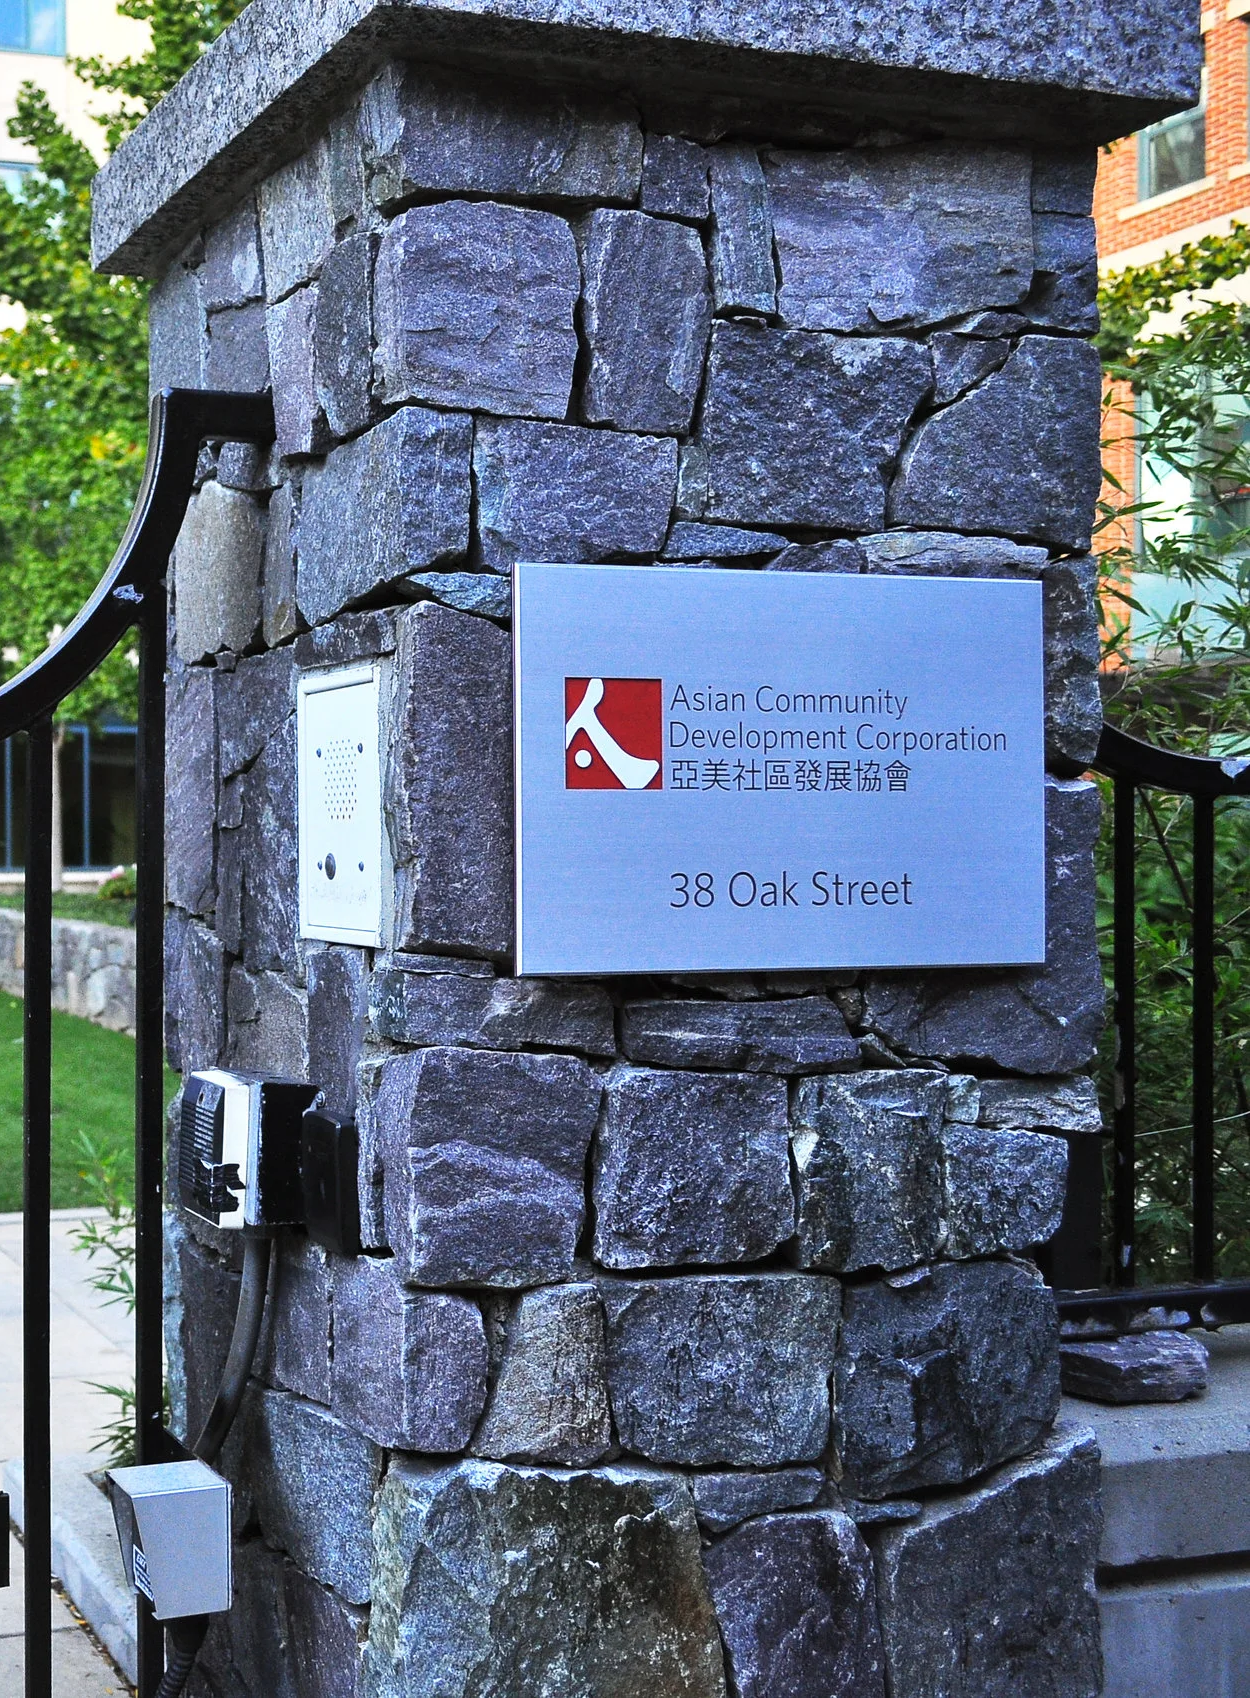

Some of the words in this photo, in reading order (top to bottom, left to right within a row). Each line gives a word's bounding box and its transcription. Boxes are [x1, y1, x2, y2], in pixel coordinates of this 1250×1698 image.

[669, 683, 746, 712] Asian
[755, 685, 909, 721] Community
[669, 721, 848, 756] Development
[856, 723, 1007, 757] Corporation
[669, 758, 912, 792] 亞美社區發展協會
[669, 872, 715, 909] 38
[728, 870, 800, 908] Oak
[811, 870, 913, 907] Street
